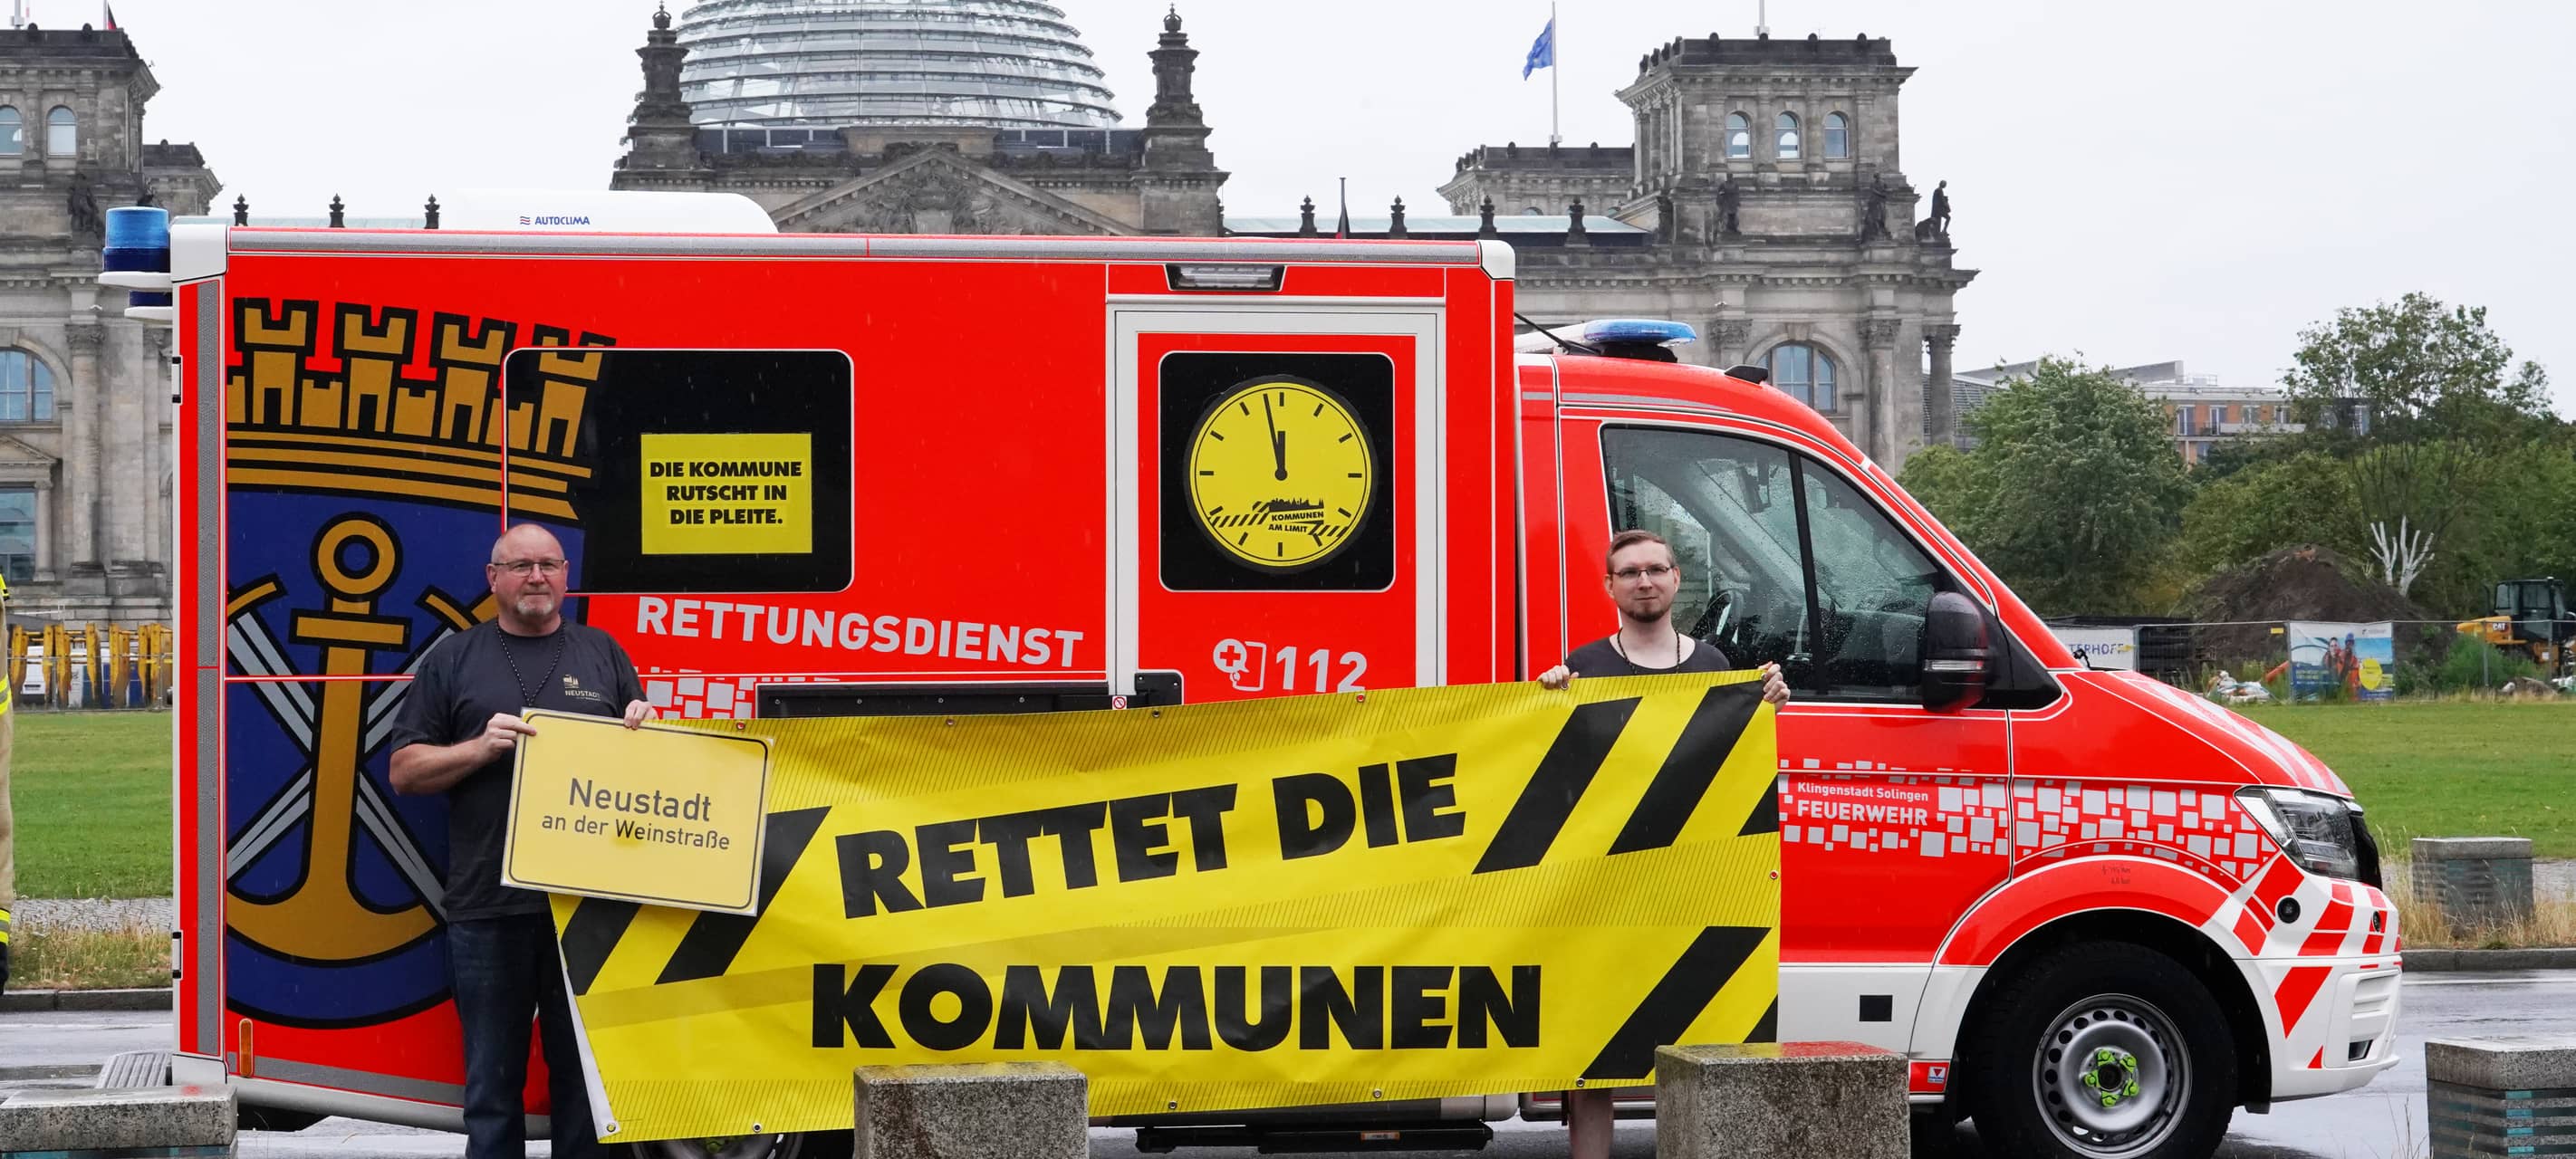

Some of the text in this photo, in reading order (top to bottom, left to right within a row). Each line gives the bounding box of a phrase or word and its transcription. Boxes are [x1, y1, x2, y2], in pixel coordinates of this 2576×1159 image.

[534, 216, 590, 225] AUTOCLIMA
[649, 462, 802, 477] DIE KOMMUNE
[666, 485, 787, 501] RUTSCHT IN
[670, 509, 783, 524] DIE PLEITE.
[1272, 512, 1324, 522] KOMMUNEN
[1284, 524, 1307, 532] LIMIT
[637, 596, 1084, 667] RETTUNGSDIENST
[2493, 623, 2506, 631] CAT
[1275, 646, 1368, 694] 112
[569, 778, 711, 822] Neustadt
[1797, 781, 1928, 802] Klingenstadt Solingen
[1797, 799, 1928, 826] FEUERWEHR
[542, 814, 730, 850] an der Weinstraße
[834, 752, 1466, 918] RETTET DIE
[811, 963, 1542, 1051] KOMMUNEN
